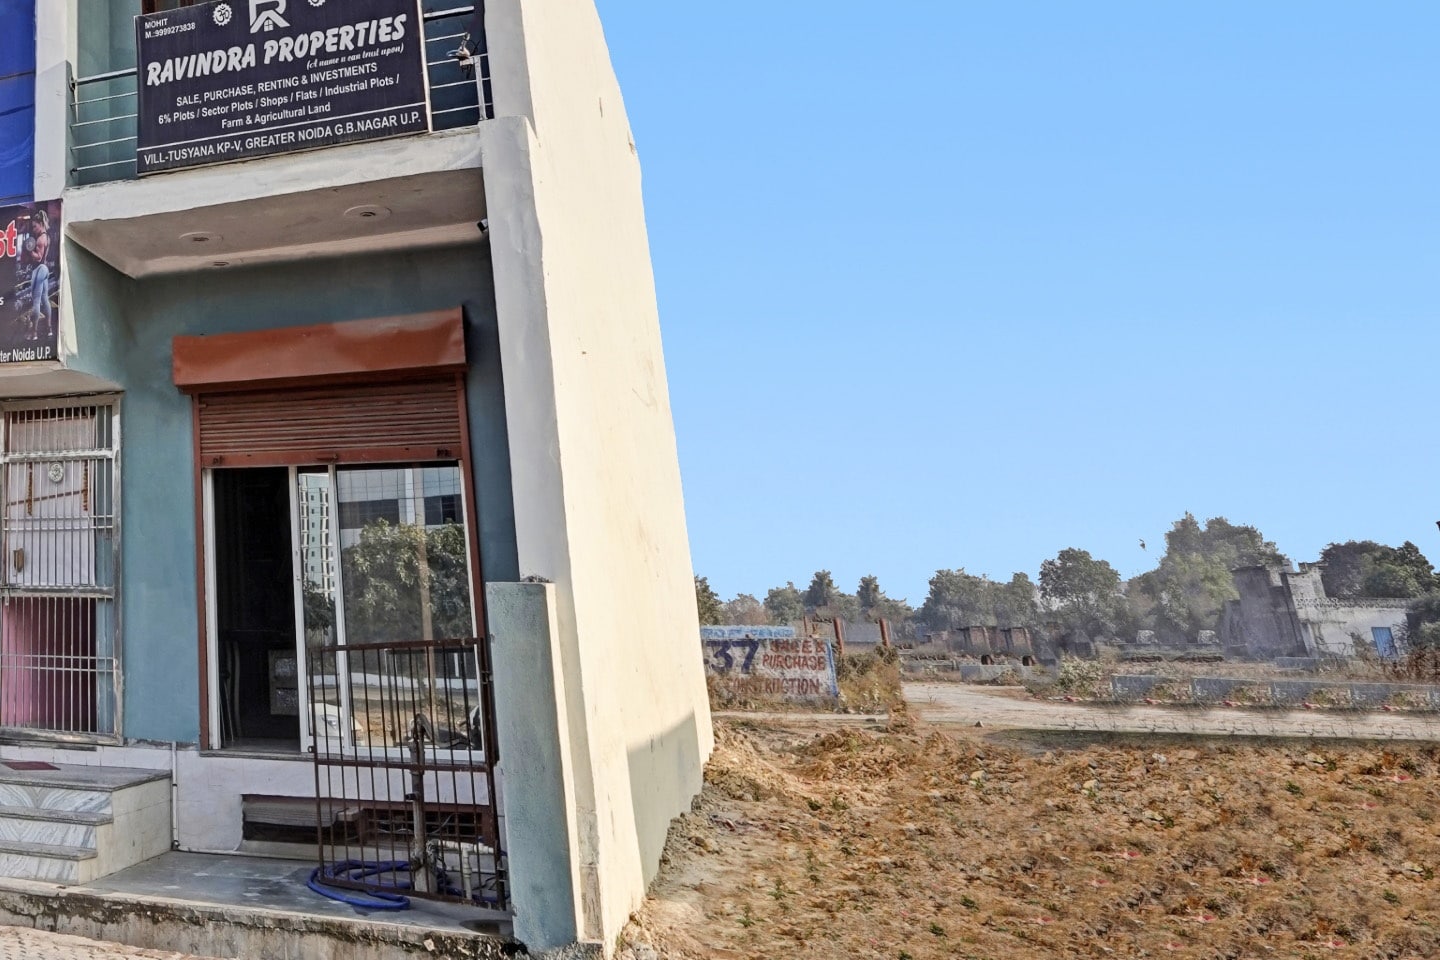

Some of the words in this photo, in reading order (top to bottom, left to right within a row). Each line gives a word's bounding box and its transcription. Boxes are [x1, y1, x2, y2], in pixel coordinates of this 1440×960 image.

[145, 18, 168, 29] MOHIT
[146, 43, 255, 87] RAVINDRA
[263, 13, 407, 65] PROPERTIES
[176, 93, 202, 107] SALE,
[204, 84, 256, 102] PURCHASE,
[257, 76, 299, 93] RENTING
[301, 74, 308, 85] &
[310, 62, 378, 83] INVESTMENTS
[158, 113, 171, 125] 6%
[173, 110, 195, 122] Plots
[201, 105, 229, 117] Sector
[231, 101, 253, 113] Plots
[260, 94, 289, 107] Shops
[295, 90, 318, 102] Flats
[324, 80, 368, 97] Industrial
[370, 76, 394, 89] Plots
[221, 118, 244, 129] Farm
[245, 114, 253, 125] &
[254, 106, 305, 125] Agricultural
[308, 102, 331, 115] Land
[144, 141, 215, 166] VILL-TUSYANA
[217, 139, 243, 155] KP-V,
[245, 128, 296, 150] GREATER
[298, 123, 333, 142] NOIDA
[334, 115, 398, 135] G.B.NAGAR
[400, 111, 421, 125] U.P.
[12, 348, 35, 362] Noida
[37, 345, 52, 359] U.P.
[770, 639, 813, 653] SALE
[762, 654, 826, 671] PURCHASE
[729, 677, 821, 696] ONSTRUCTION
